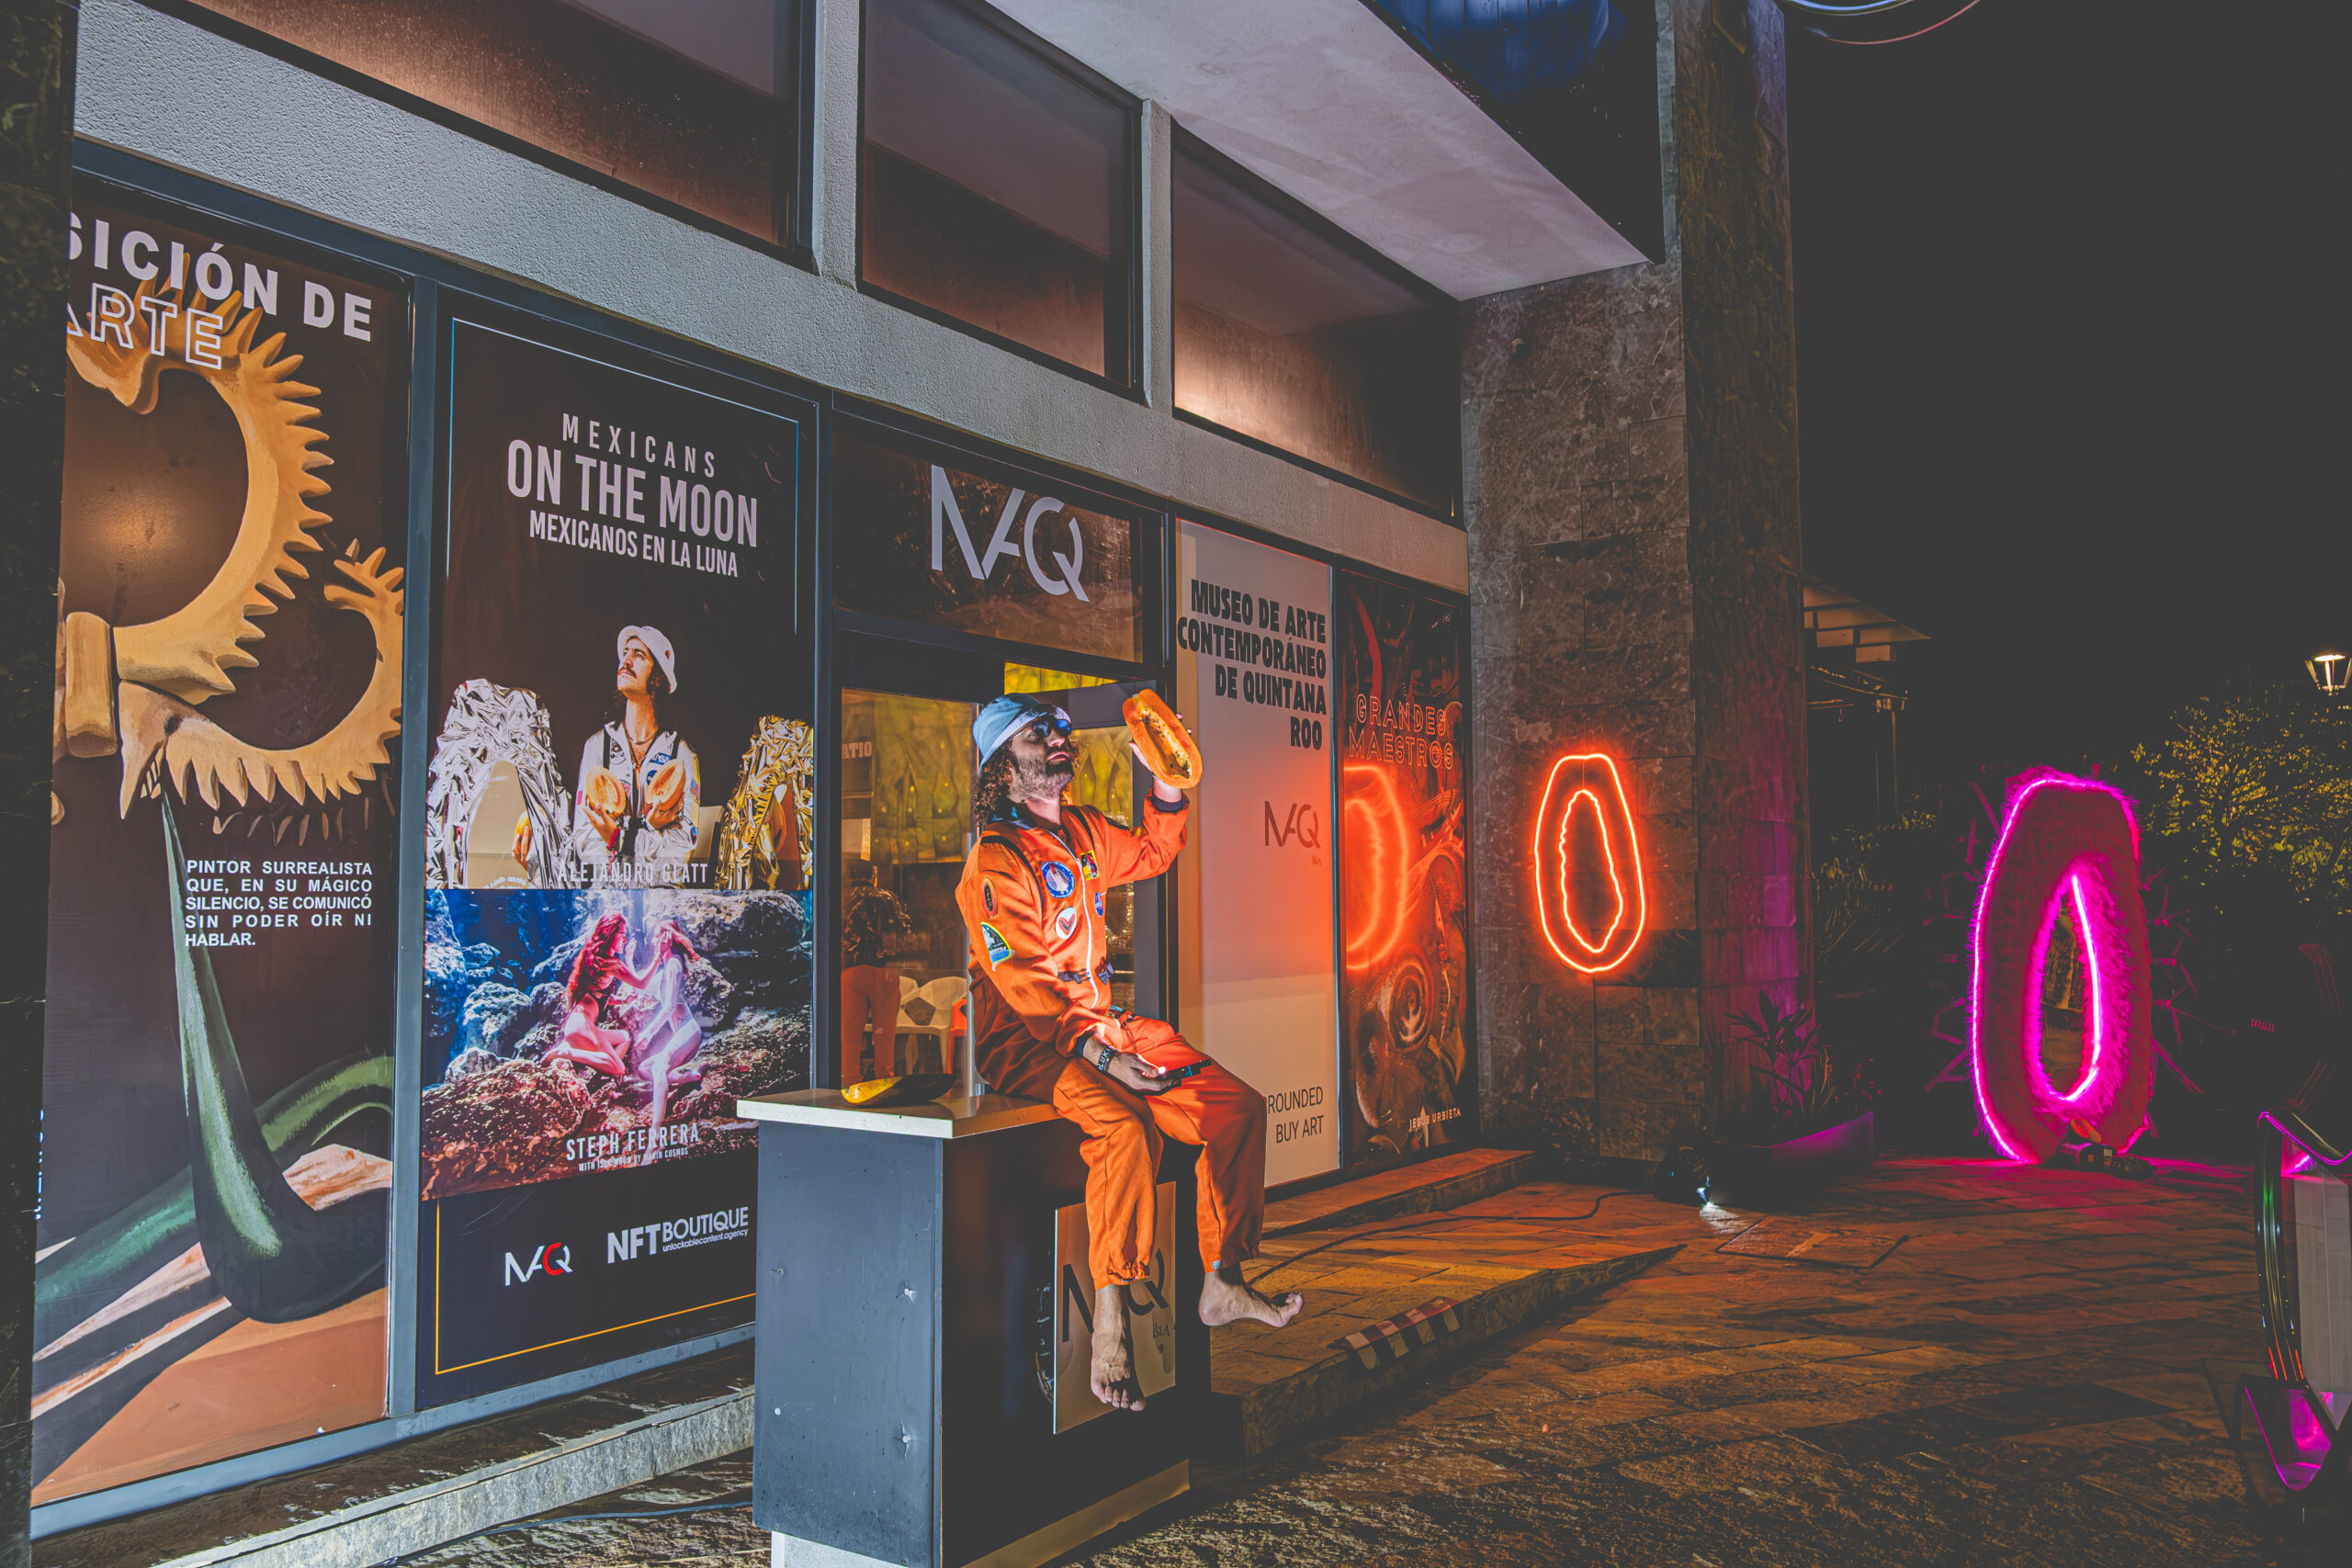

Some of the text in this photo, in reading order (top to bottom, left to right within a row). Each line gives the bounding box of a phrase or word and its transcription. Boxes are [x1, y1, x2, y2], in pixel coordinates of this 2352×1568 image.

[303, 280, 372, 342] DE
[562, 412, 715, 478] MEXICANS
[507, 439, 757, 547] ON THE MOON
[529, 509, 739, 578] MEXICANOS EN LA LUNA
[1191, 578, 1327, 644] MUSEO DE ARTE
[1177, 616, 1327, 680] CONTEMPORÁNEO
[1215, 663, 1328, 716] DE QUINTANA
[1356, 693, 1446, 736] GRANDES
[1290, 716, 1323, 750] ROO
[1349, 726, 1453, 770] MAESTROS
[187, 860, 373, 875] PINTOR SURREALISTA
[559, 862, 708, 884] ALEJANDRO GLATT
[186, 876, 373, 894] QUE, EN SU MÁGICO
[186, 894, 372, 911] SILENCIO, SE COMUNICÓ
[185, 911, 372, 929] SIN PODER OÍR NI
[185, 932, 256, 947] HABLAR.
[1276, 1114, 1324, 1144] BUY ART
[1431, 1107, 1462, 1123] URBIETA
[566, 1122, 699, 1161] STEPH FERRERA
[664, 1146, 689, 1158] COSMOS
[662, 1229, 749, 1253] unlockablecontent.agency
